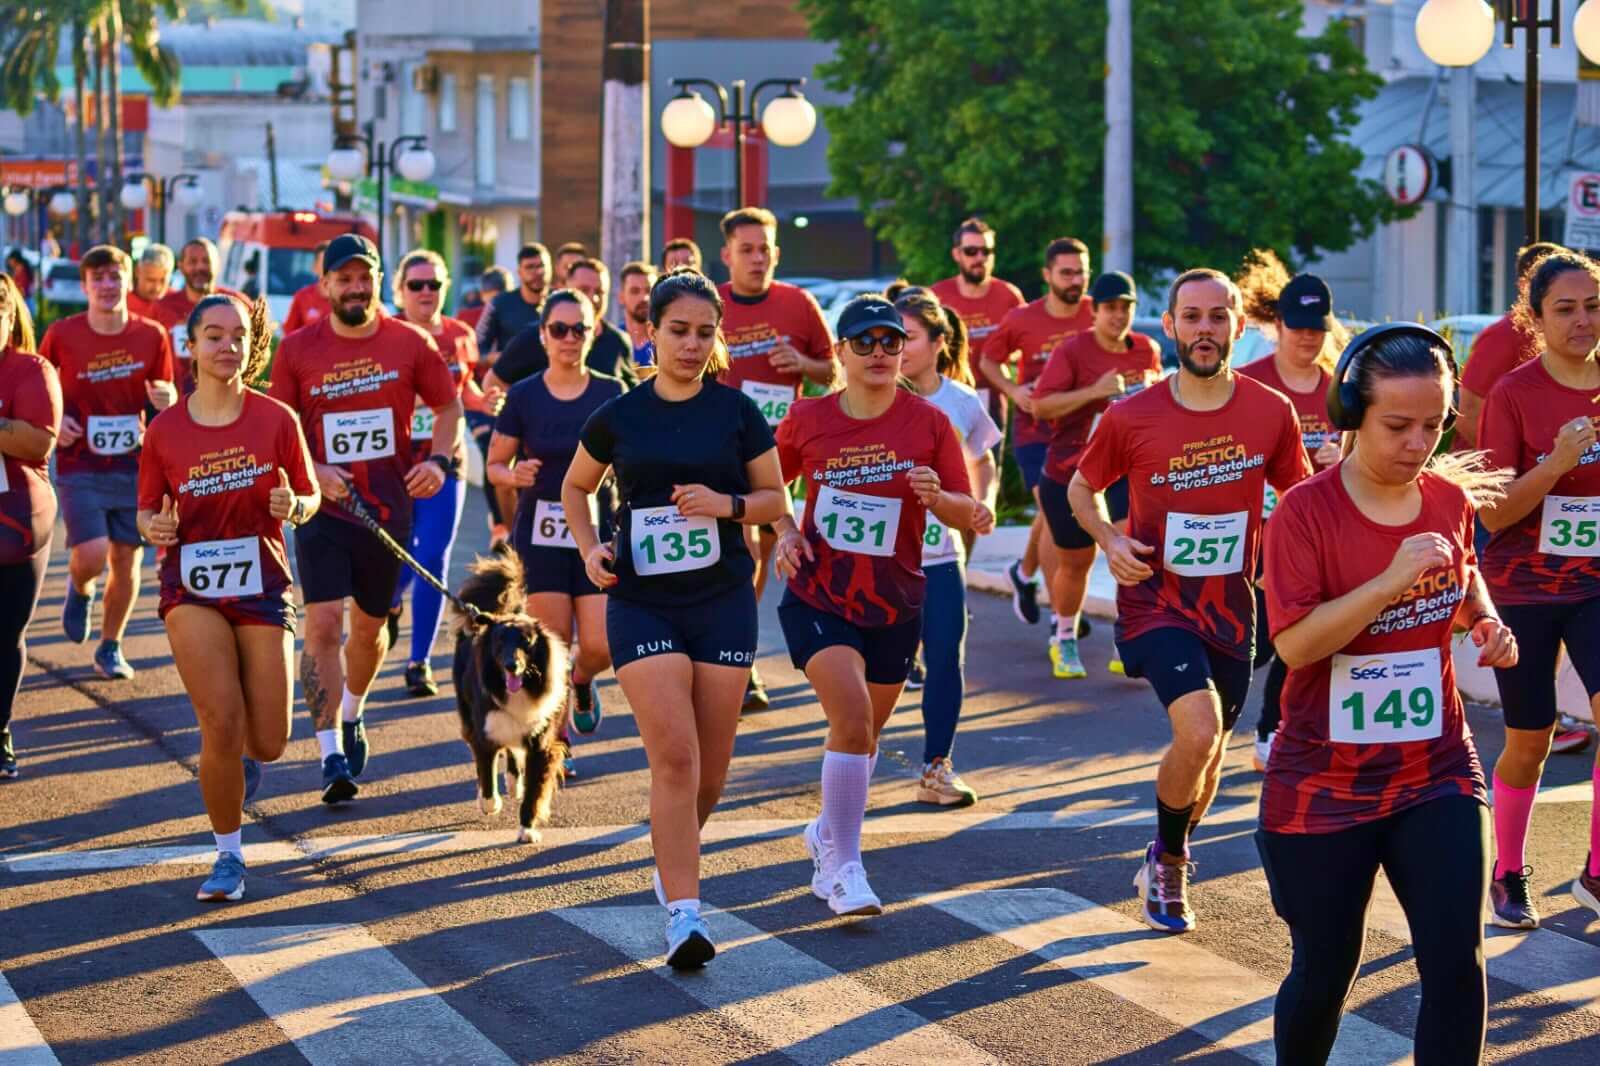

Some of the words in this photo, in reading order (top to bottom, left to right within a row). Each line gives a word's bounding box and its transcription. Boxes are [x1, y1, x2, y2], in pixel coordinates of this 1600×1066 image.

[310, 384, 321, 396] do
[322, 380, 352, 394] Super
[754, 399, 789, 420] 46
[93, 430, 135, 448] 673
[332, 427, 389, 455] 675
[1183, 435, 1234, 451] PRIMEIRA
[178, 482, 188, 494] do
[188, 474, 221, 490] Super
[222, 462, 273, 482] Bertoletti
[813, 469, 824, 481] do
[825, 468, 858, 482] Super
[860, 459, 914, 476] Bertoletti
[1150, 472, 1166, 485] do
[1168, 467, 1207, 484] Super
[1208, 453, 1265, 476] Bertoletti
[193, 477, 254, 497] 04/05/2025
[829, 473, 894, 489] 04/05/2025
[1173, 471, 1243, 492] 04/05/2025
[832, 496, 859, 510] Sesc
[1560, 502, 1588, 513] Sesc
[540, 517, 569, 539] 67
[644, 515, 671, 527] Sesc
[822, 512, 887, 548] 131
[1184, 519, 1212, 530] Sesc
[924, 523, 942, 546] 8
[1549, 518, 1599, 548] 35
[640, 528, 711, 565] 135
[1171, 534, 1240, 566] 257
[189, 560, 253, 592] 677
[1371, 605, 1411, 624] uper
[636, 639, 673, 656] RUN
[1350, 667, 1389, 680] Sesc
[1342, 686, 1435, 731] 149
